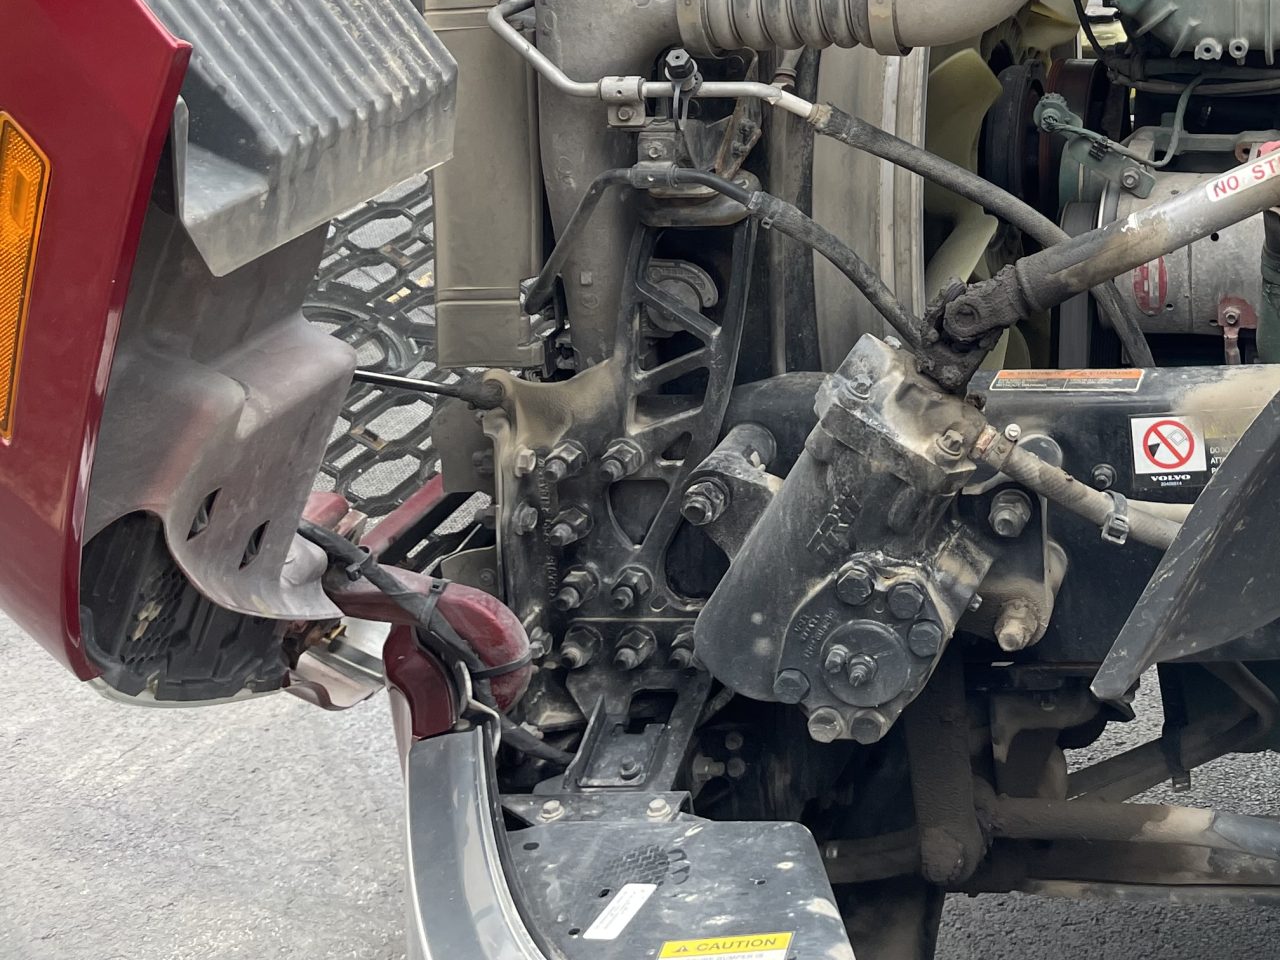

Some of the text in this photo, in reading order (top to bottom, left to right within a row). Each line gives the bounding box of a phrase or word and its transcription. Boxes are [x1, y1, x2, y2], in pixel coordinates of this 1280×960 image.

[1213, 175, 1240, 198] NO
[1210, 446, 1220, 454] DO
[1210, 456, 1225, 464] ATT
[696, 938, 777, 952] CAUTION
